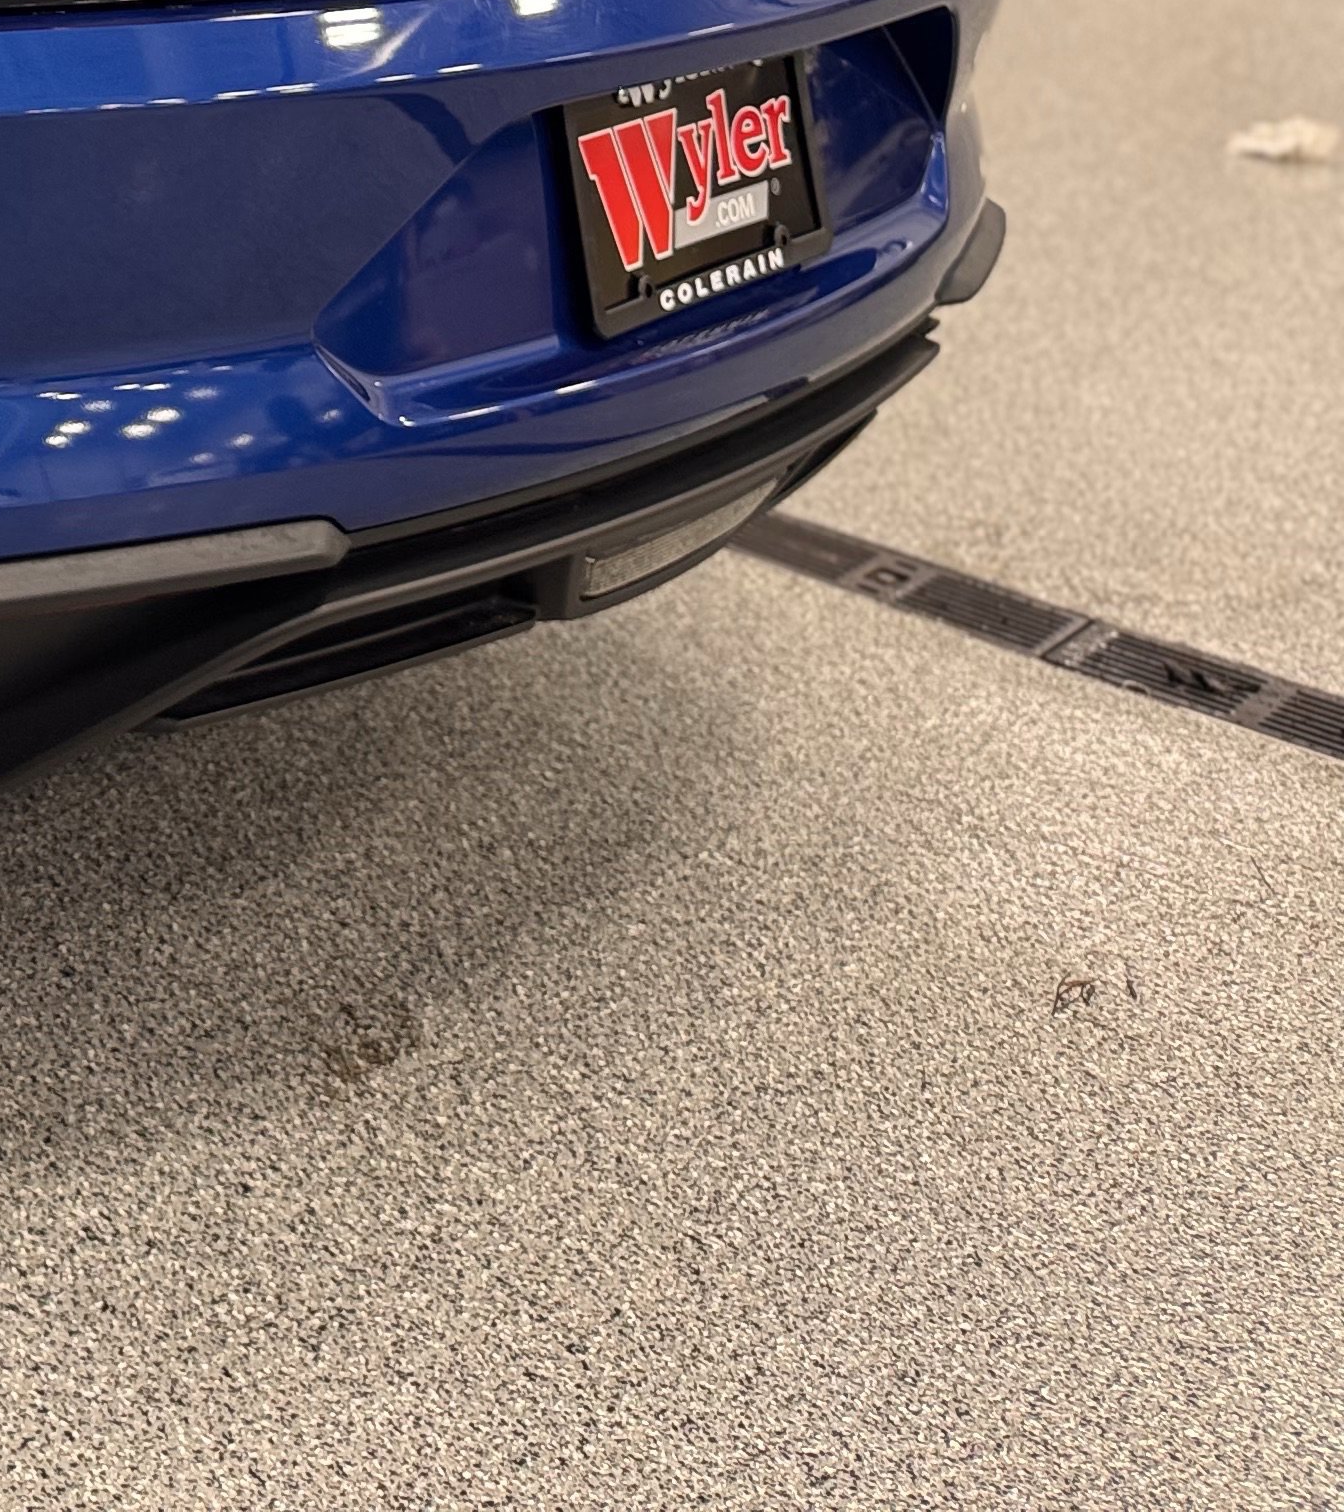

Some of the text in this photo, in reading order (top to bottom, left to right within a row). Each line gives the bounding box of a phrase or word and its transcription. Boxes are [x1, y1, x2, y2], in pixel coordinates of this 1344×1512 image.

[578, 88, 792, 273] Wyler
[715, 192, 756, 228] .COM
[659, 246, 786, 312] COLERAIN
